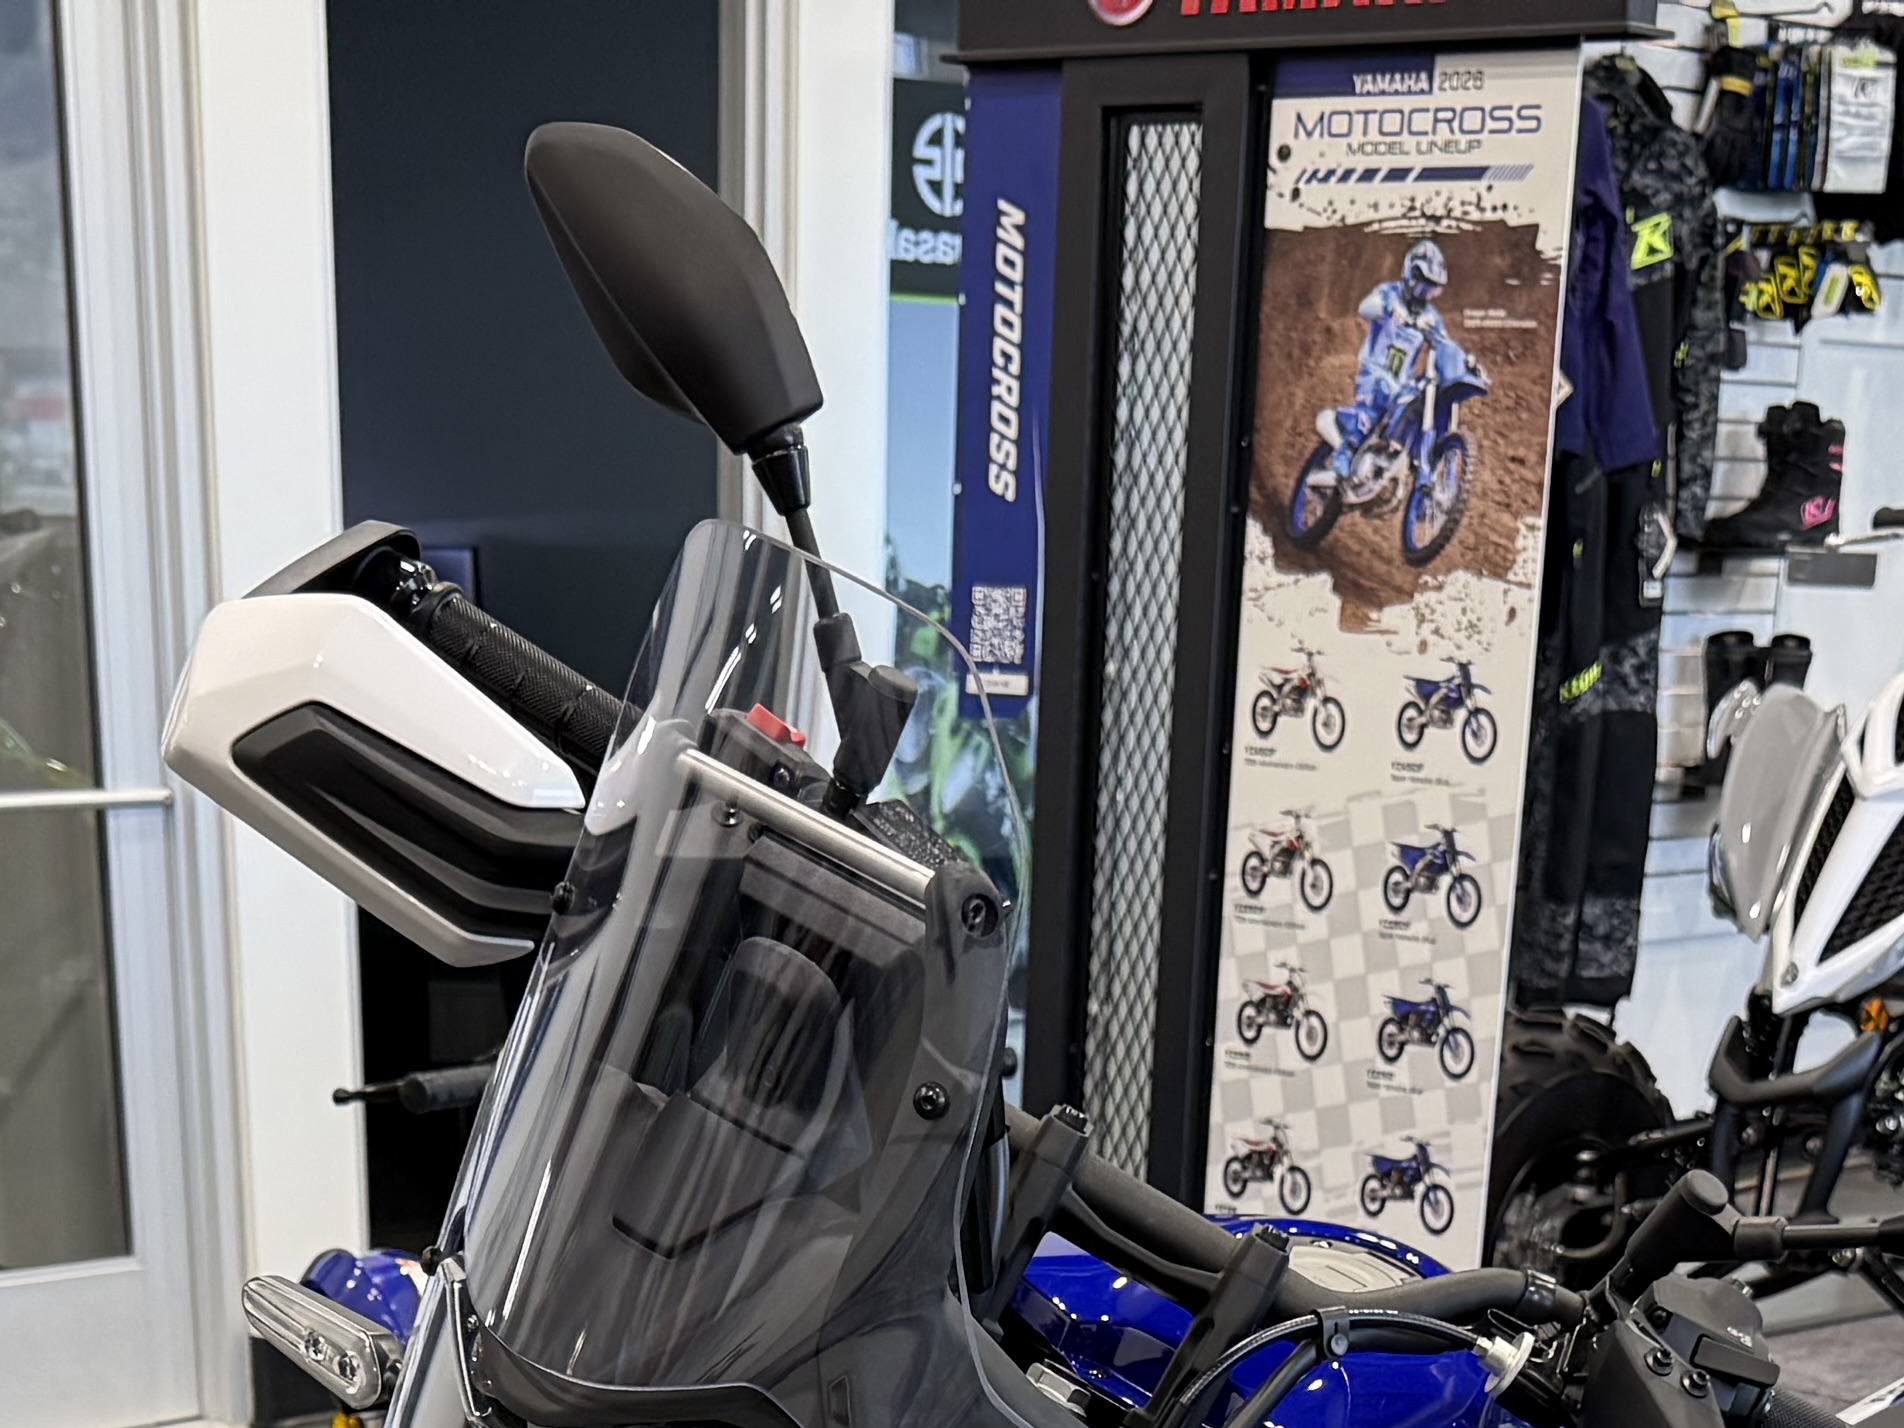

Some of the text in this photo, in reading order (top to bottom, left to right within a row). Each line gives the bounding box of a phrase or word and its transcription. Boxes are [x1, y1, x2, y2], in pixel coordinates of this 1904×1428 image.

[1352, 71, 1430, 94] YAMAHA
[1294, 105, 1542, 140] MOTOCROSS
[1345, 141, 1410, 157] MODEL
[988, 198, 1027, 504] MOTOCROSS
